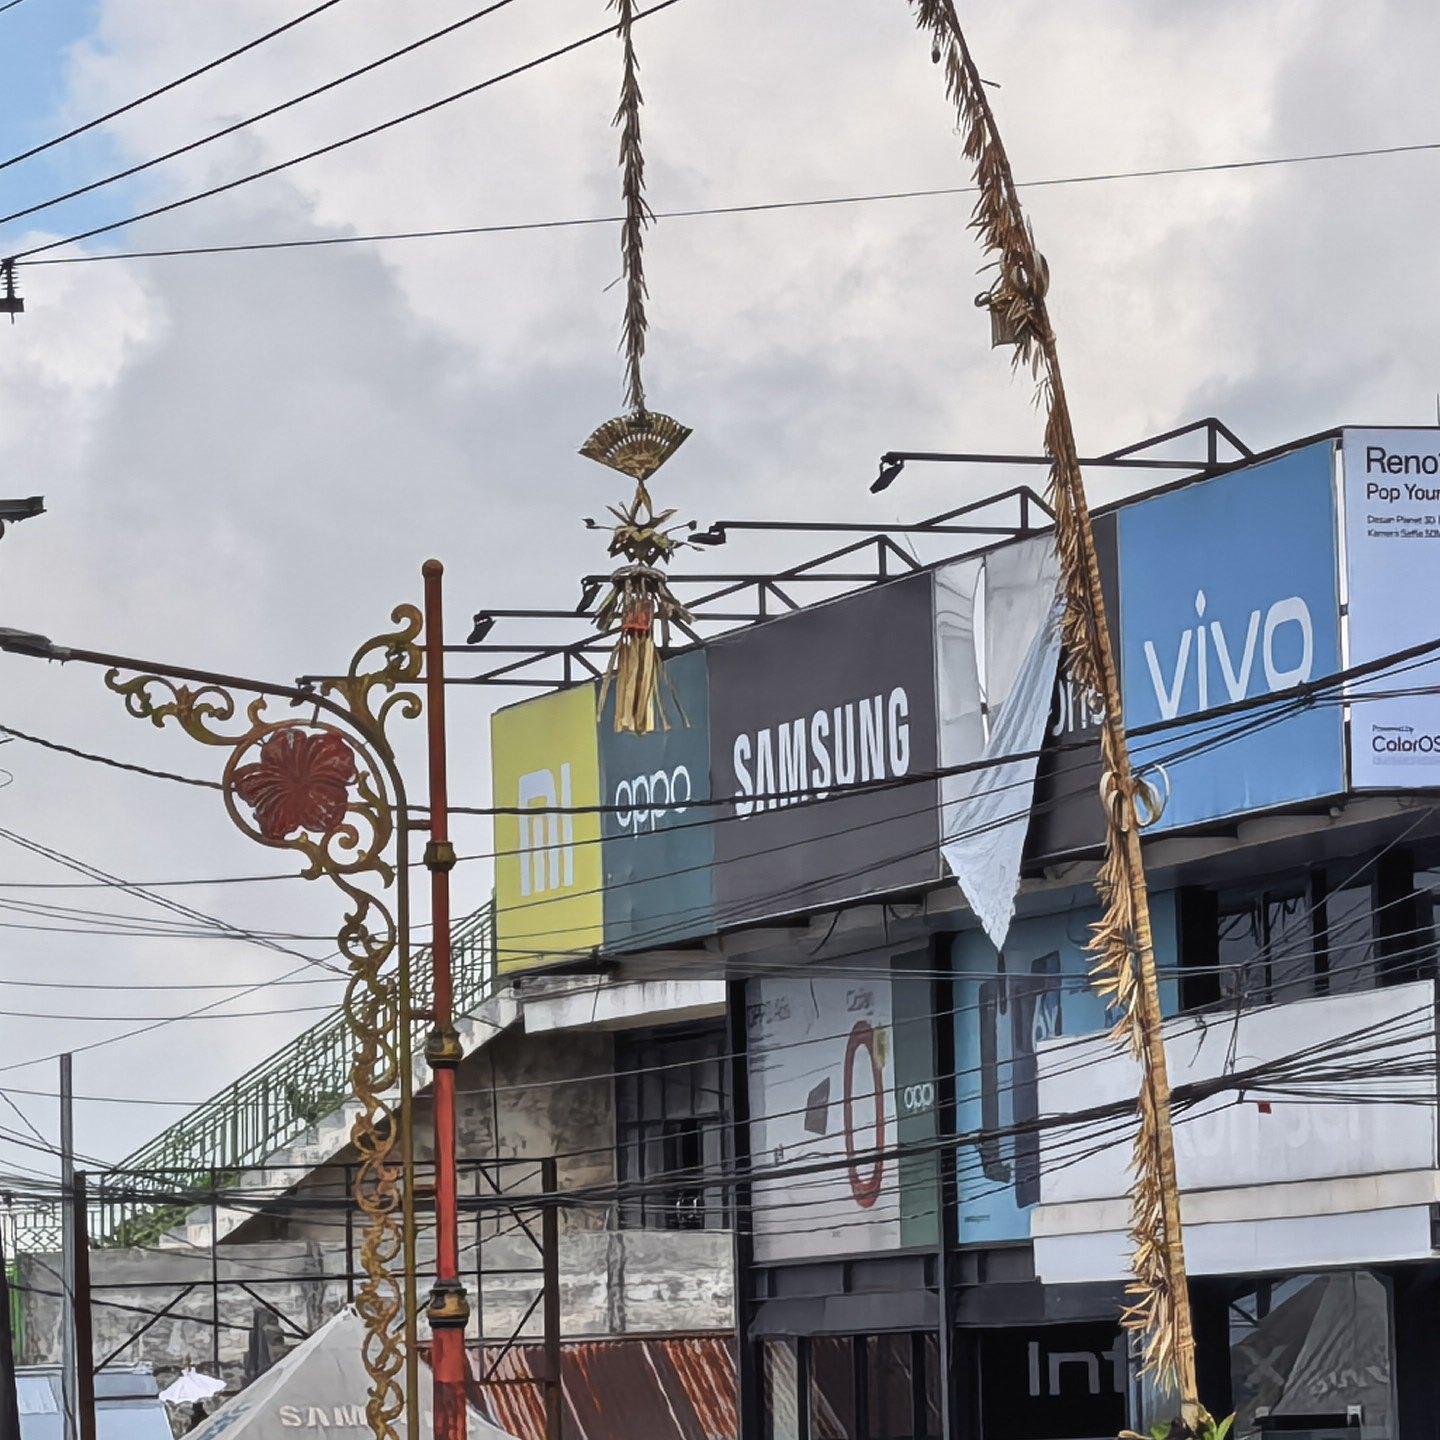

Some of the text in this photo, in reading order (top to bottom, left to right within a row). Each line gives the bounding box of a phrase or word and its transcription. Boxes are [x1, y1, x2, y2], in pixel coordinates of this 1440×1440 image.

[1367, 483, 1401, 503] Pop
[1144, 589, 1313, 720] vivo
[615, 764, 692, 838] oppo
[733, 686, 910, 819] SAMSUNG
